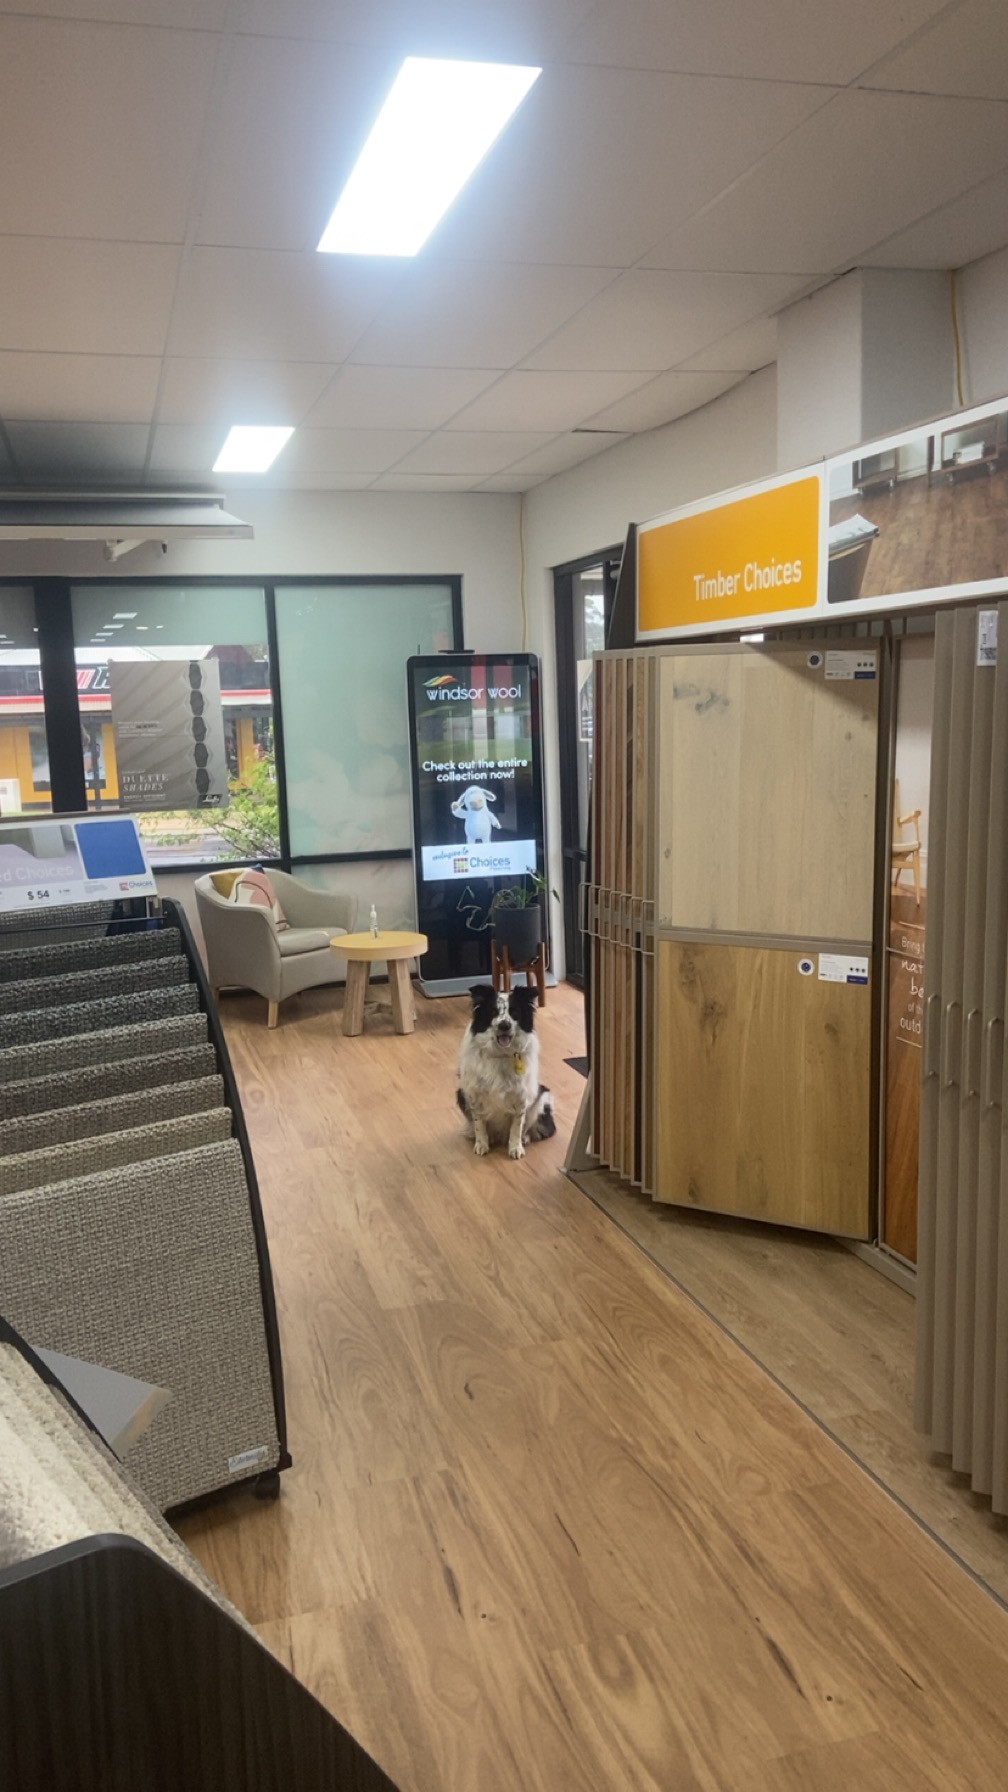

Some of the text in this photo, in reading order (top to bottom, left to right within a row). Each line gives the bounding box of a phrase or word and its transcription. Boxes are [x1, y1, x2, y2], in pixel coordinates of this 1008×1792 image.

[694, 557, 802, 601] Timber Choices
[426, 684, 521, 701] windsor wool
[422, 757, 528, 772] Check out the entire
[436, 768, 515, 782] collection now!
[470, 855, 511, 868] Choices
[15, 864, 74, 881] Choices
[901, 936, 920, 954] Bring
